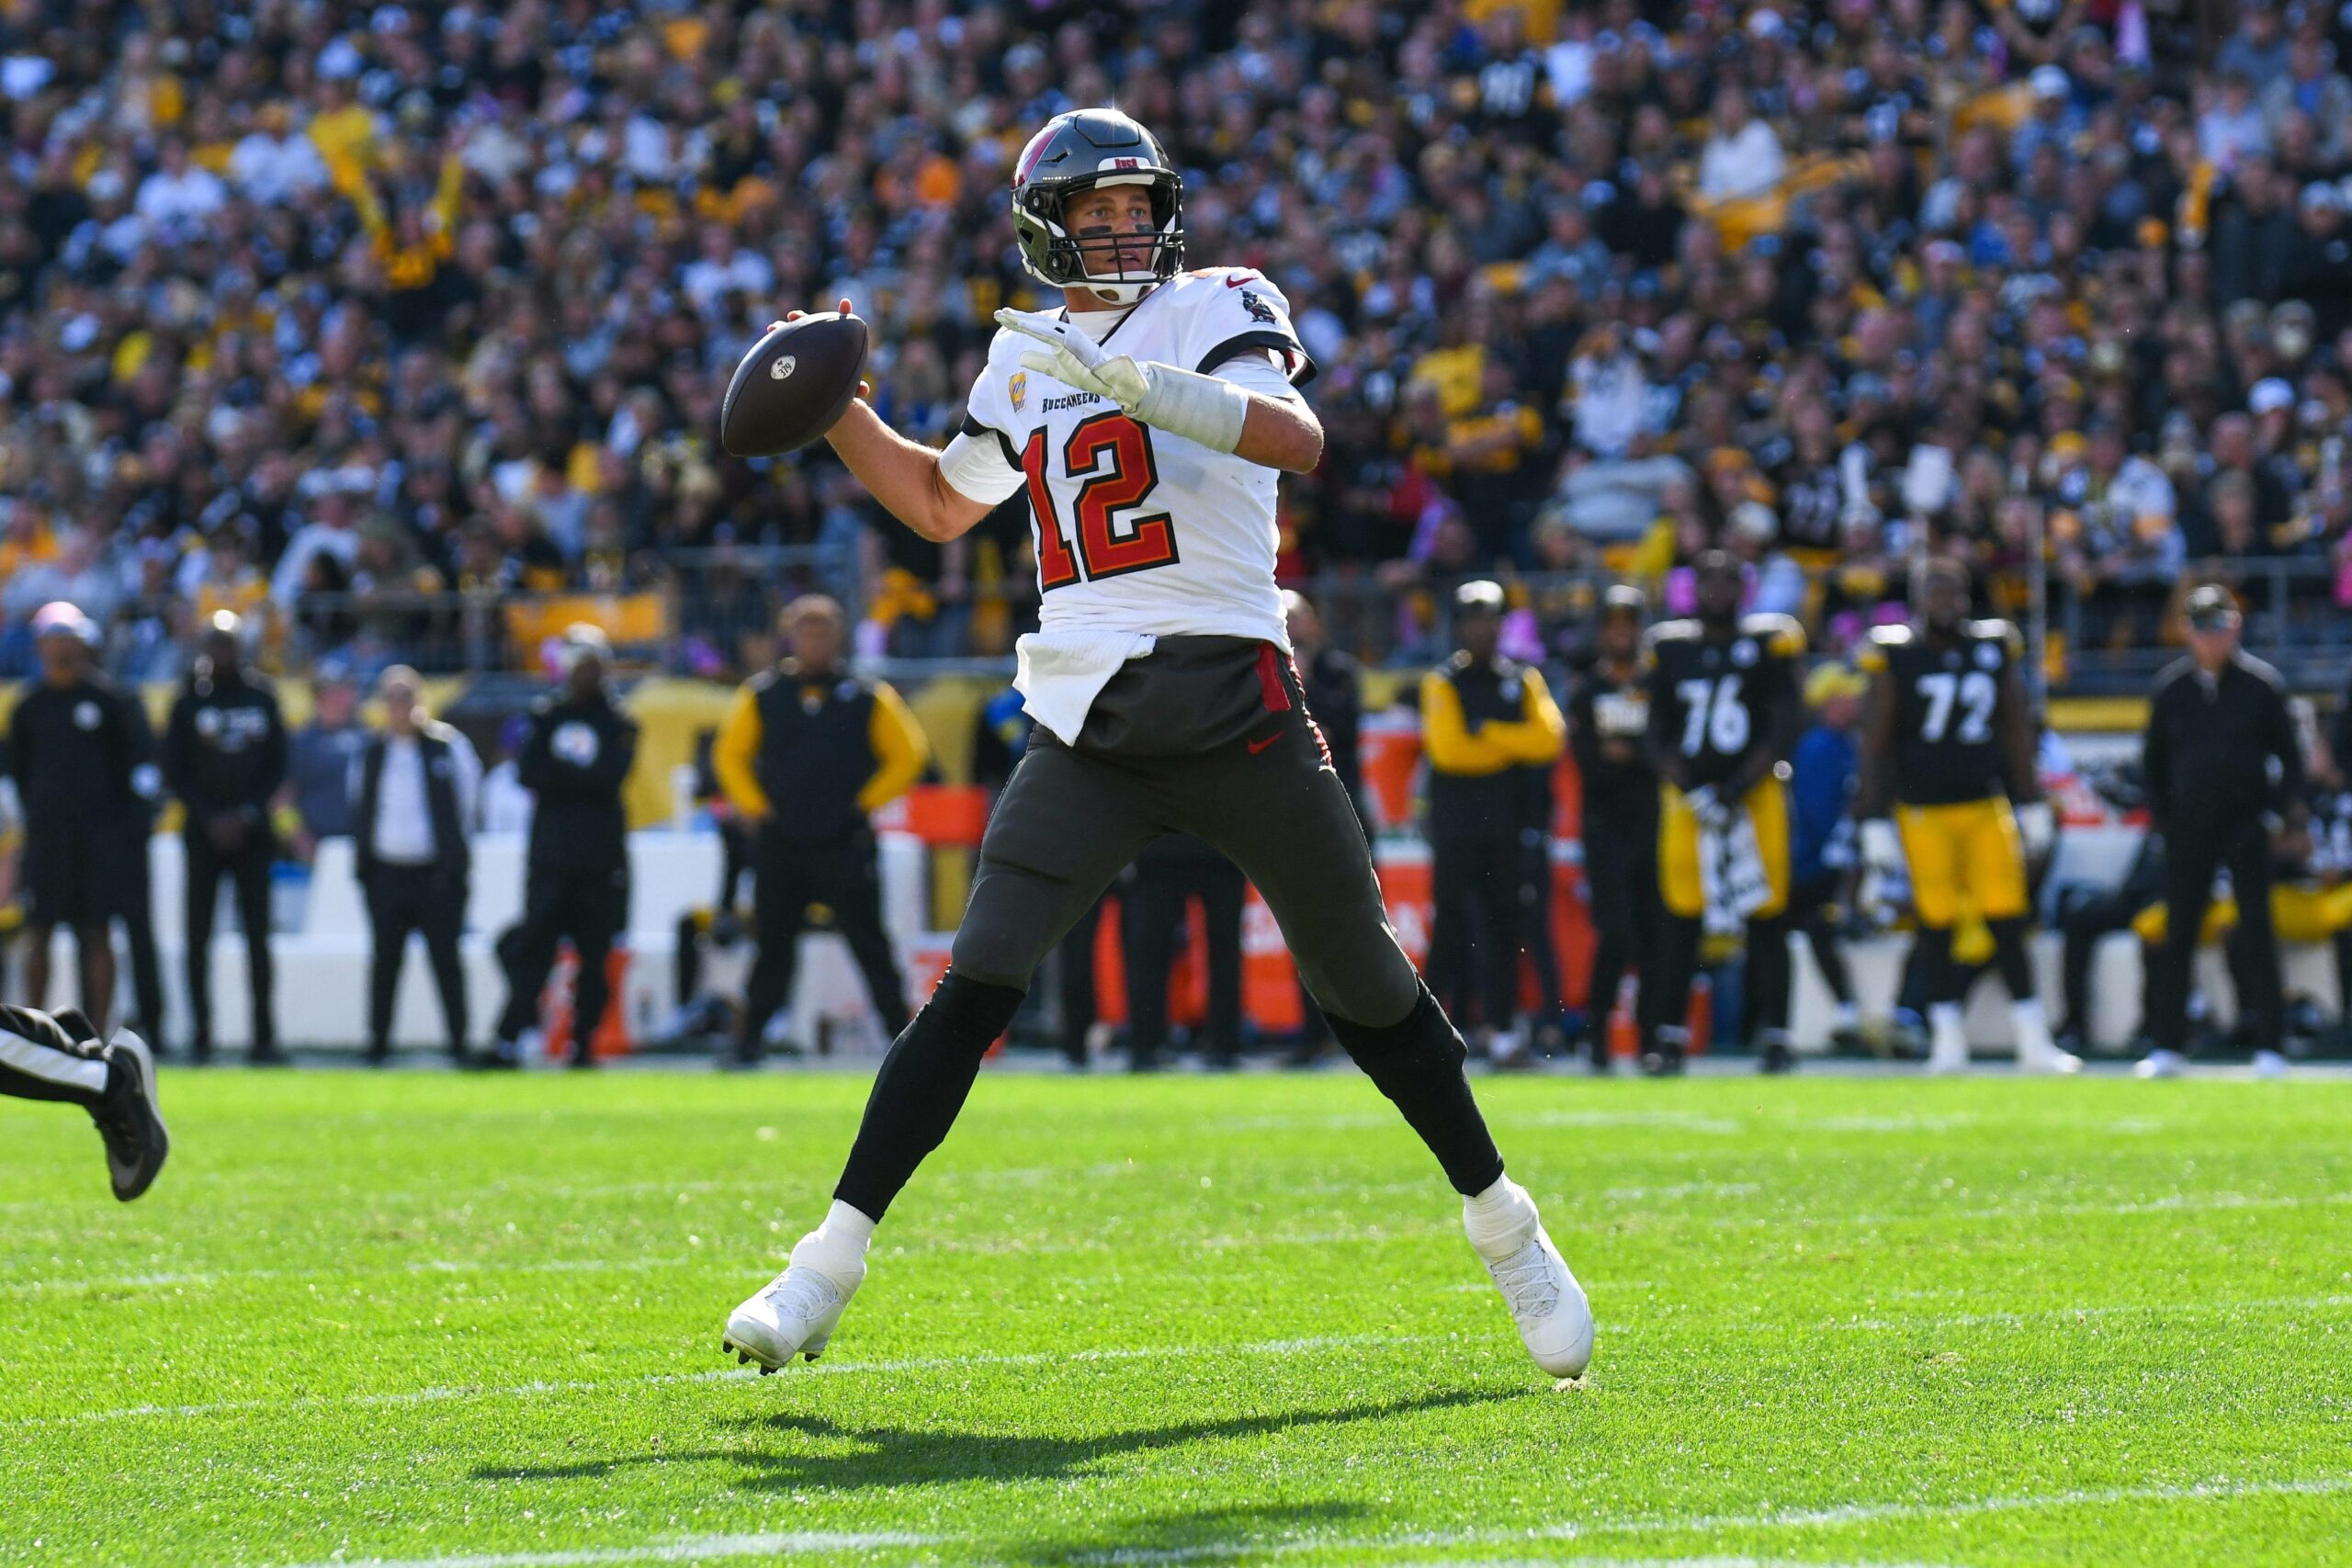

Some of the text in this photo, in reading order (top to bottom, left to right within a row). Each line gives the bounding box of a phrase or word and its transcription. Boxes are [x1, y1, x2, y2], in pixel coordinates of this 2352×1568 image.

[1042, 392, 1100, 413] BUCCANEERS
[1022, 410, 1180, 593] 12
[1675, 673, 1749, 758] 76
[1916, 671, 1996, 744] 72
